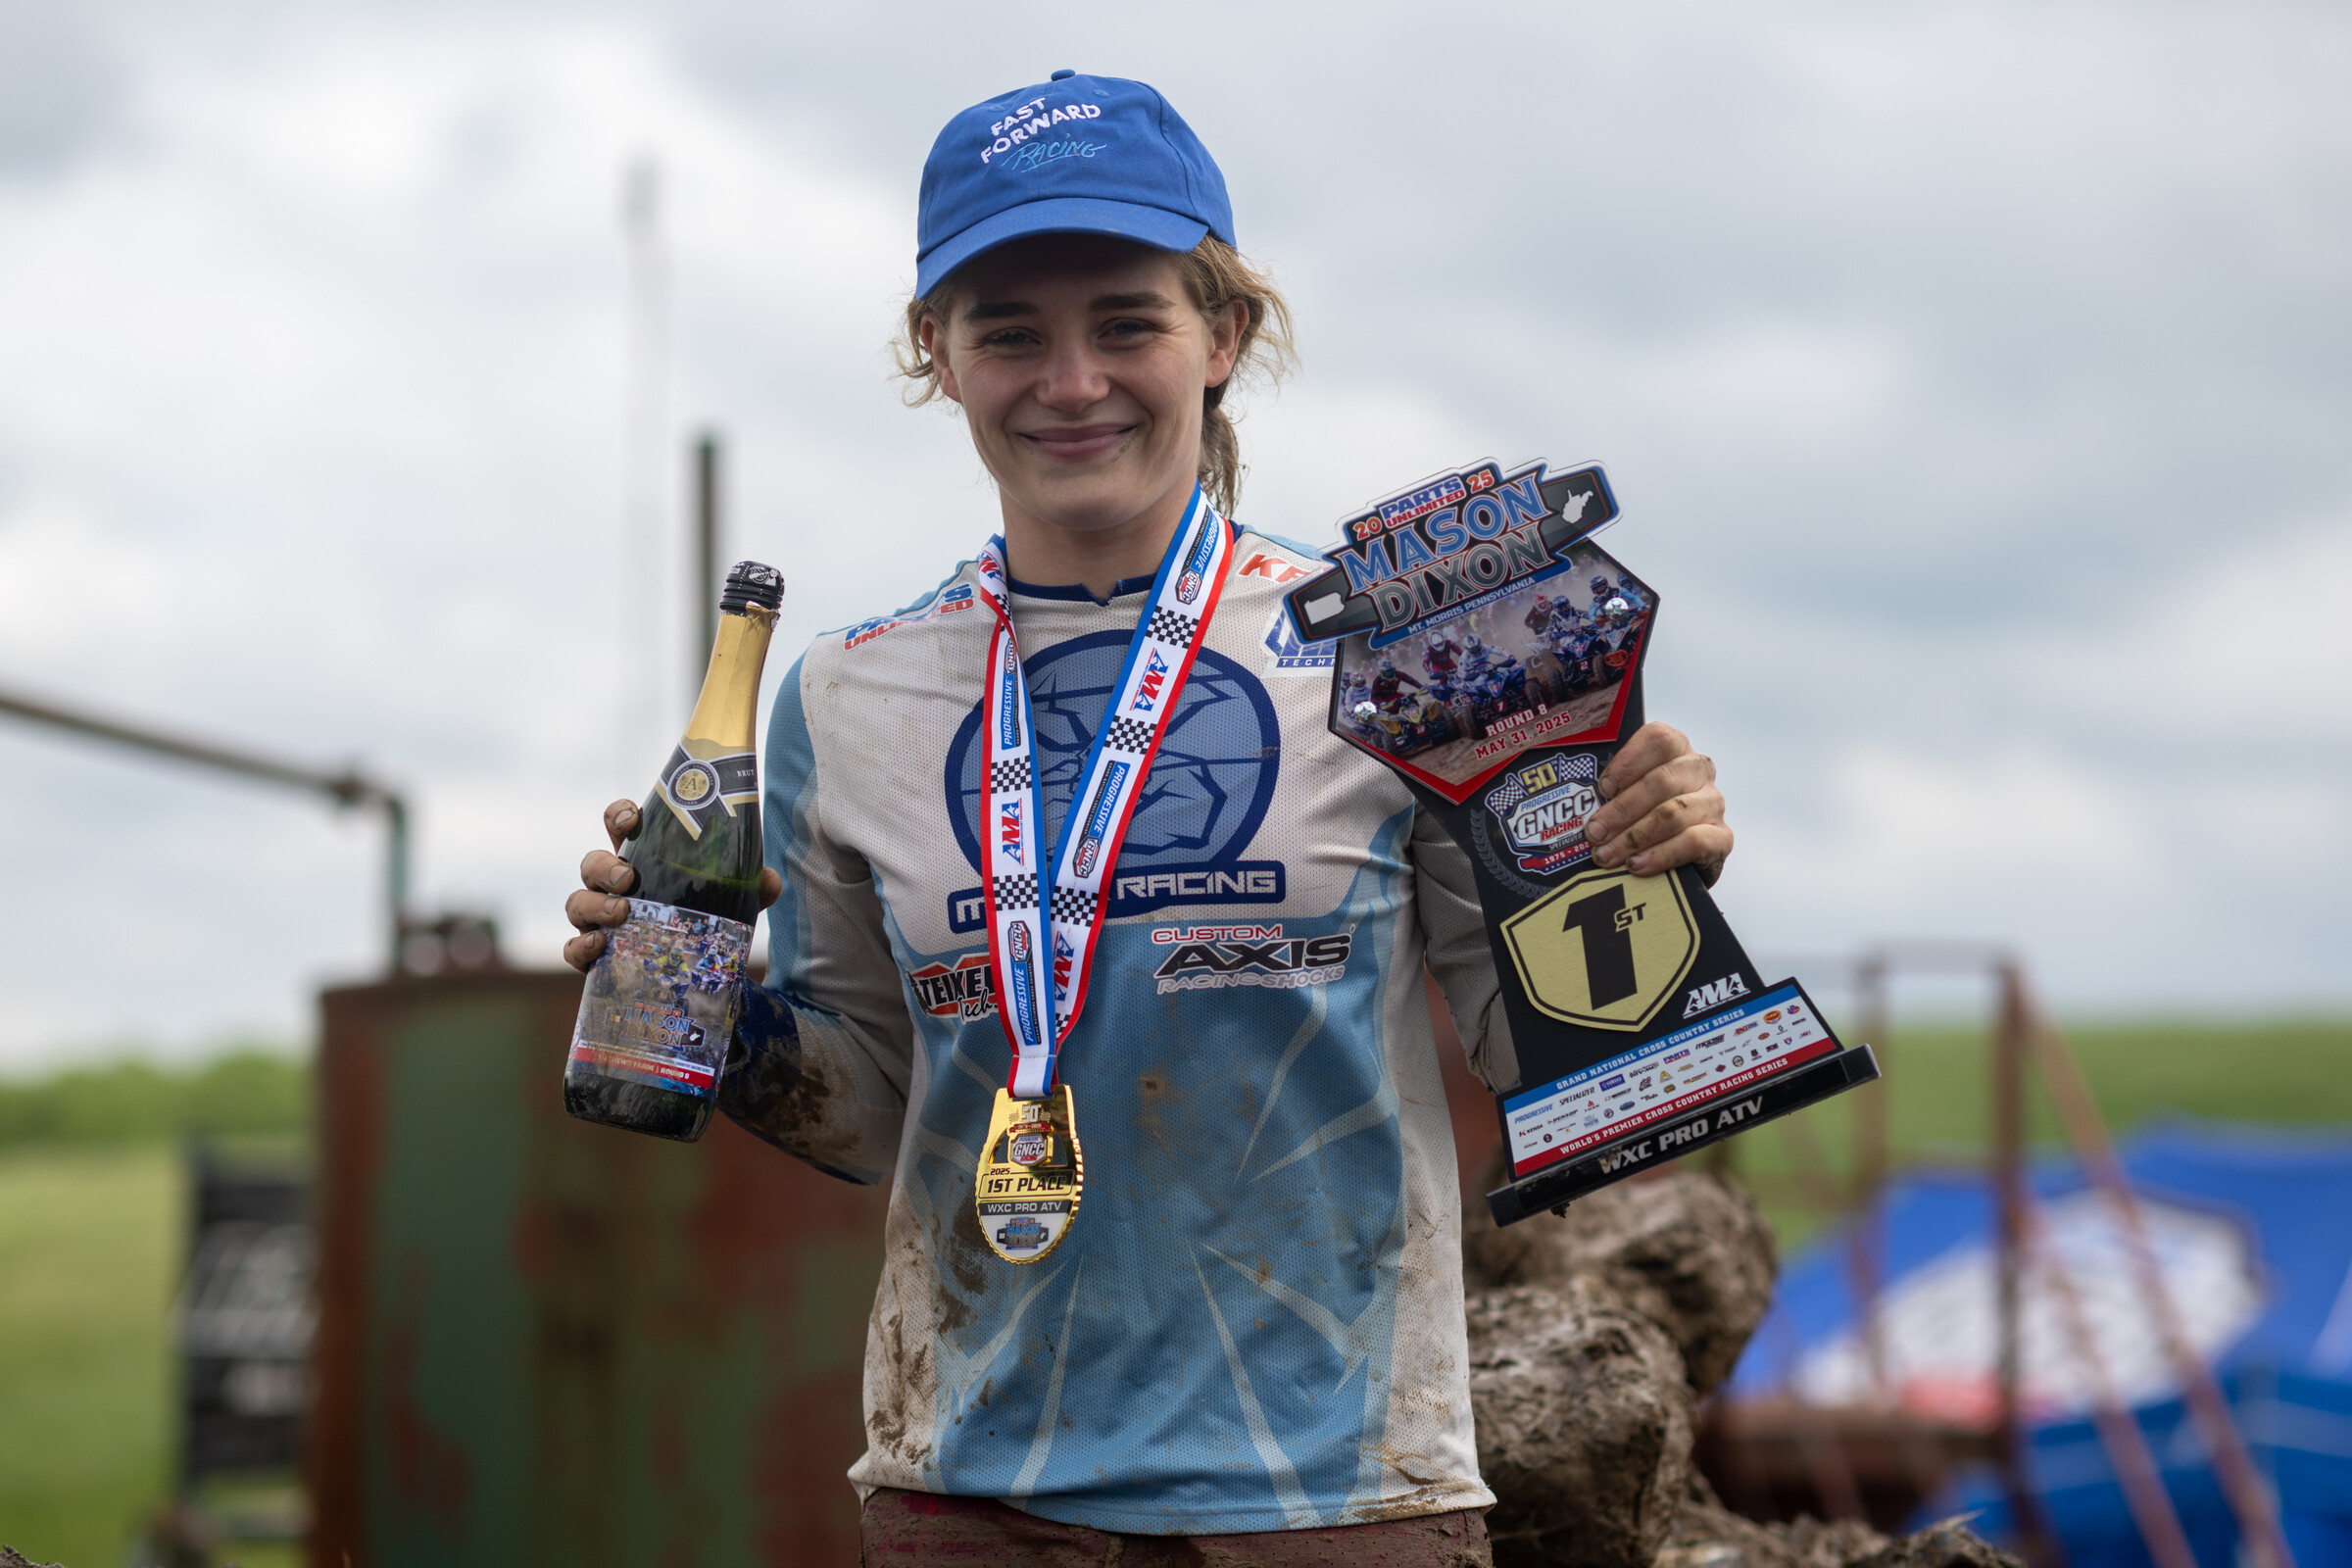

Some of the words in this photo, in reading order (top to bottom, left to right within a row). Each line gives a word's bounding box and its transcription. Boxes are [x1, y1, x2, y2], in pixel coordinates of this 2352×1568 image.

[981, 103, 1102, 165] FORWARD
[991, 97, 1047, 136] FAST
[1382, 477, 1463, 520] PARTS
[1467, 470, 1494, 493] 25
[1386, 489, 1465, 528] UNLIMITED
[1336, 472, 1555, 597] MASON
[1353, 516, 1383, 541] 20
[1180, 570, 1202, 604] GNCC
[1371, 519, 1554, 633] DIXON
[1426, 607, 1464, 628] MORRIS
[1464, 575, 1537, 616] PENNSYLVANIA
[1132, 649, 1169, 711] AMA
[1004, 679, 1012, 746] PROGRESSIVE
[1485, 711, 1536, 737] ROUND
[1538, 703, 1548, 716] 8
[1475, 738, 1509, 760] MAY
[1512, 726, 1534, 748] 31,
[1535, 710, 1571, 735] 2025
[736, 769, 755, 778] BRUT
[1094, 764, 1126, 835] PROGRESSIVE
[1517, 790, 1593, 838] GNCC
[1521, 784, 1571, 812] PROGRESSIVE
[1002, 799, 1022, 865] AMA
[1540, 816, 1584, 843] RACING
[1079, 839, 1097, 876] GNCC
[1544, 851, 1566, 865] 1975
[1117, 870, 1276, 901] RACING
[1013, 922, 1026, 961] GNCC
[1153, 925, 1281, 943] CUSTOM
[1054, 932, 1075, 1002] AMA
[1154, 935, 1351, 977] AXIS
[1015, 966, 1034, 1043] PROGRESSIVE
[1683, 972, 1750, 1016] AMA
[1556, 1072, 1588, 1091] GRAND
[1590, 1053, 1637, 1077] NATIONAL
[1638, 1041, 1667, 1057] CROSS
[1669, 1022, 1710, 1045] COUNTRY
[1712, 1008, 1745, 1028] SERIES
[660, 1066, 684, 1079] ROUND
[1021, 1103, 1040, 1123] 50
[1514, 1103, 1553, 1125] PROGRESSIVE
[1560, 1133, 1601, 1155] WORLD'S
[1603, 1116, 1643, 1139] PREMIER
[1645, 1104, 1674, 1120] CROSS
[1675, 1087, 1717, 1108] COUNTRY
[1720, 1072, 1754, 1091] RACING
[1755, 1057, 1788, 1077] SERIES
[1013, 1142, 1045, 1157] GNCC
[1597, 1141, 1653, 1175] WXC
[1658, 1118, 1709, 1152] PRO
[1716, 1096, 1763, 1130] ATV
[987, 1179, 1014, 1194] 1ST
[1016, 1176, 1064, 1192] PLACE
[990, 1167, 1011, 1176] 2025
[987, 1203, 1012, 1213] WXC
[1014, 1202, 1038, 1212] PRO
[1040, 1201, 1062, 1211] ATV
[1006, 1224, 1041, 1236] MASON
